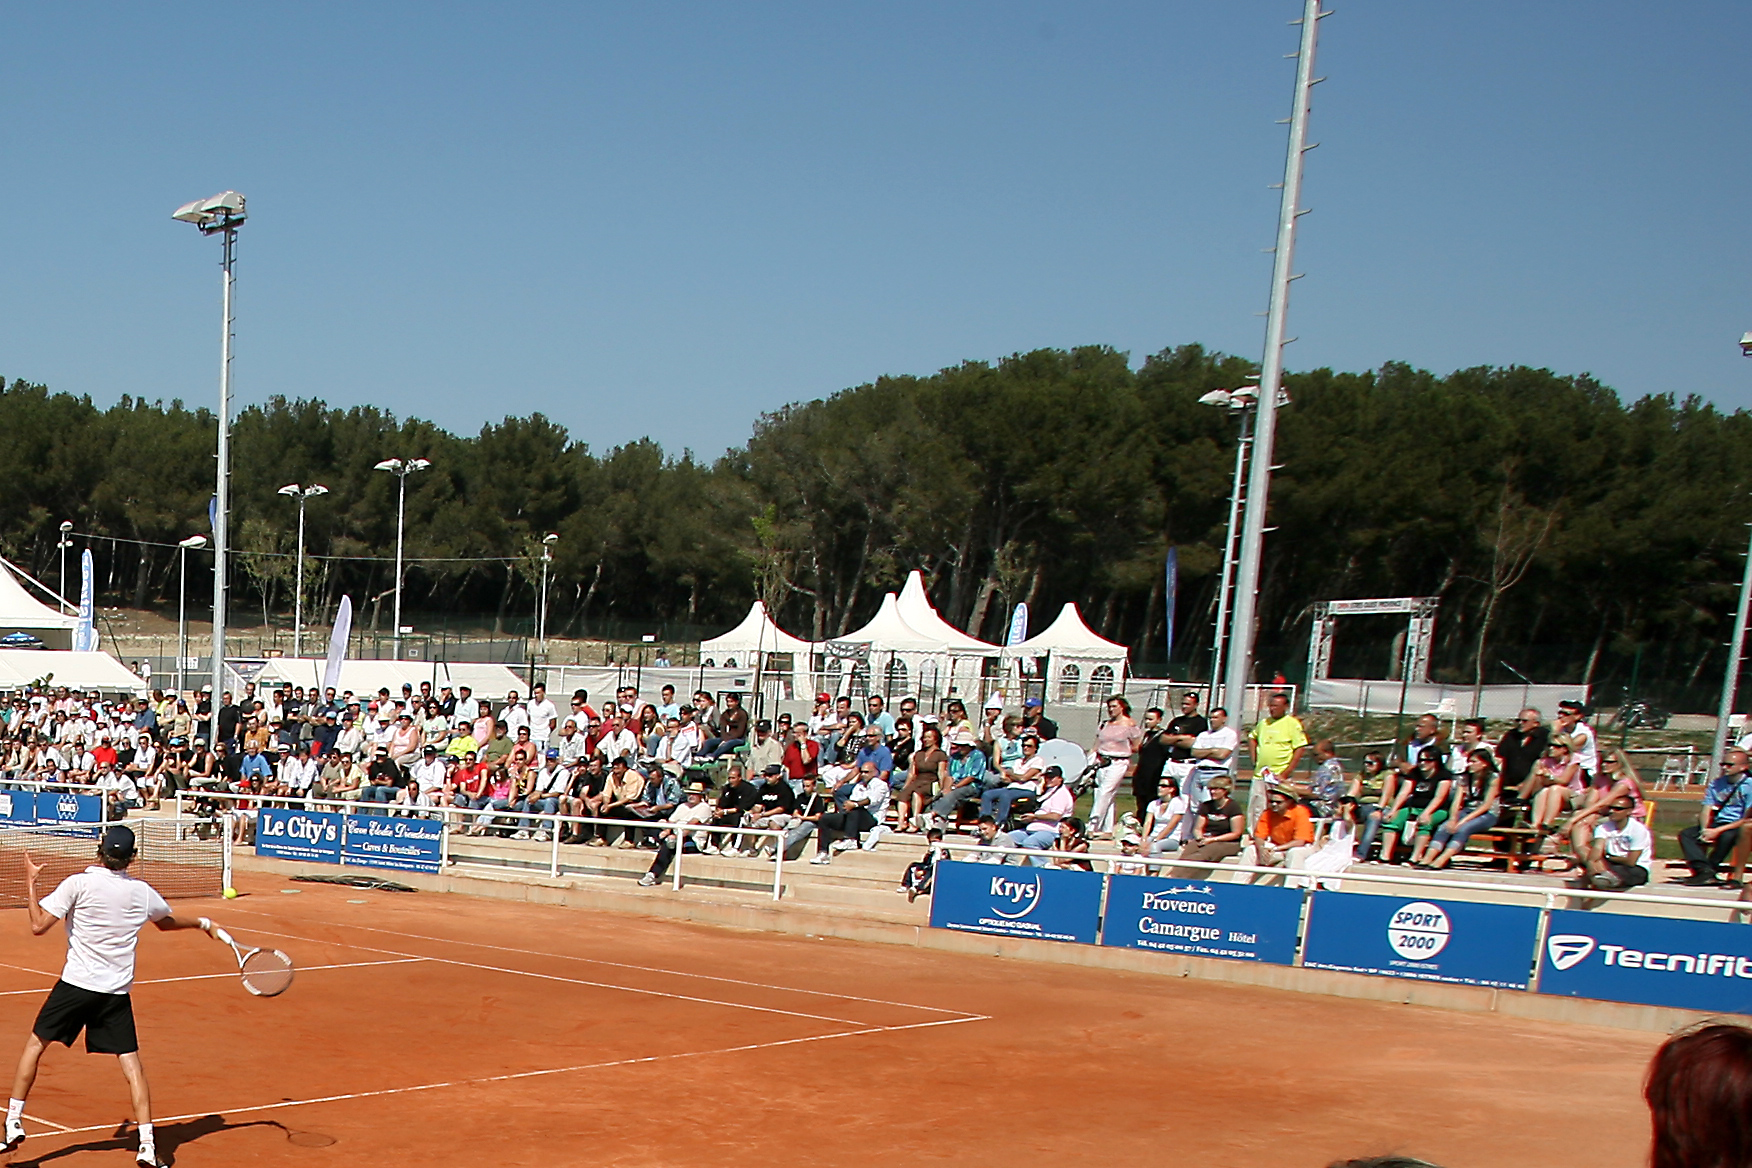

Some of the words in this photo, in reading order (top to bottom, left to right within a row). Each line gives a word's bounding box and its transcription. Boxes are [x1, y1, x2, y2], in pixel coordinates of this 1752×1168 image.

[262, 814, 284, 837] Le
[286, 815, 338, 845] City's
[990, 876, 1036, 903] Krys
[1141, 892, 1216, 916] Provence
[1137, 916, 1221, 942] Camargue
[1227, 931, 1257, 944] Hôtel
[1394, 911, 1443, 929] SPORT
[1397, 935, 1436, 950] 2000
